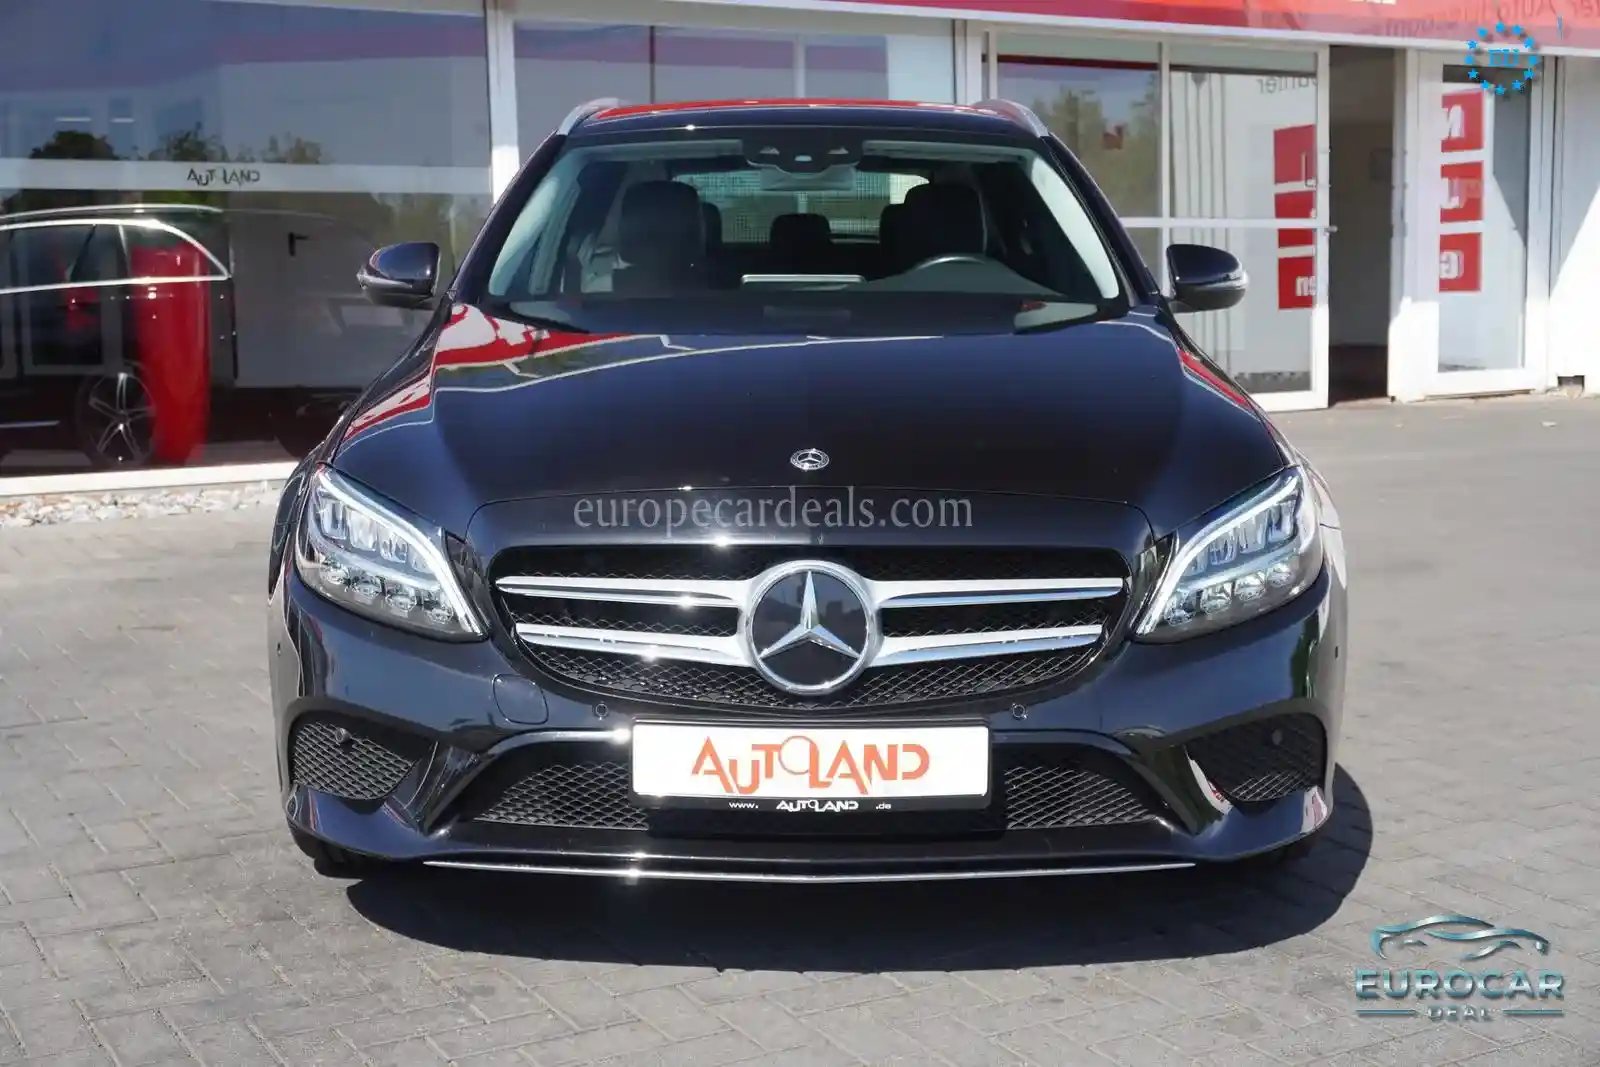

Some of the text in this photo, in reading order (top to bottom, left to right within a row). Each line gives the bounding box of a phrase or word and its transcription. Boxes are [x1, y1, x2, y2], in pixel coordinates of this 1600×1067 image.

[691, 735, 931, 796] AUTOLAND
[728, 802, 759, 810] www.
[776, 799, 859, 812] AUTOLAND
